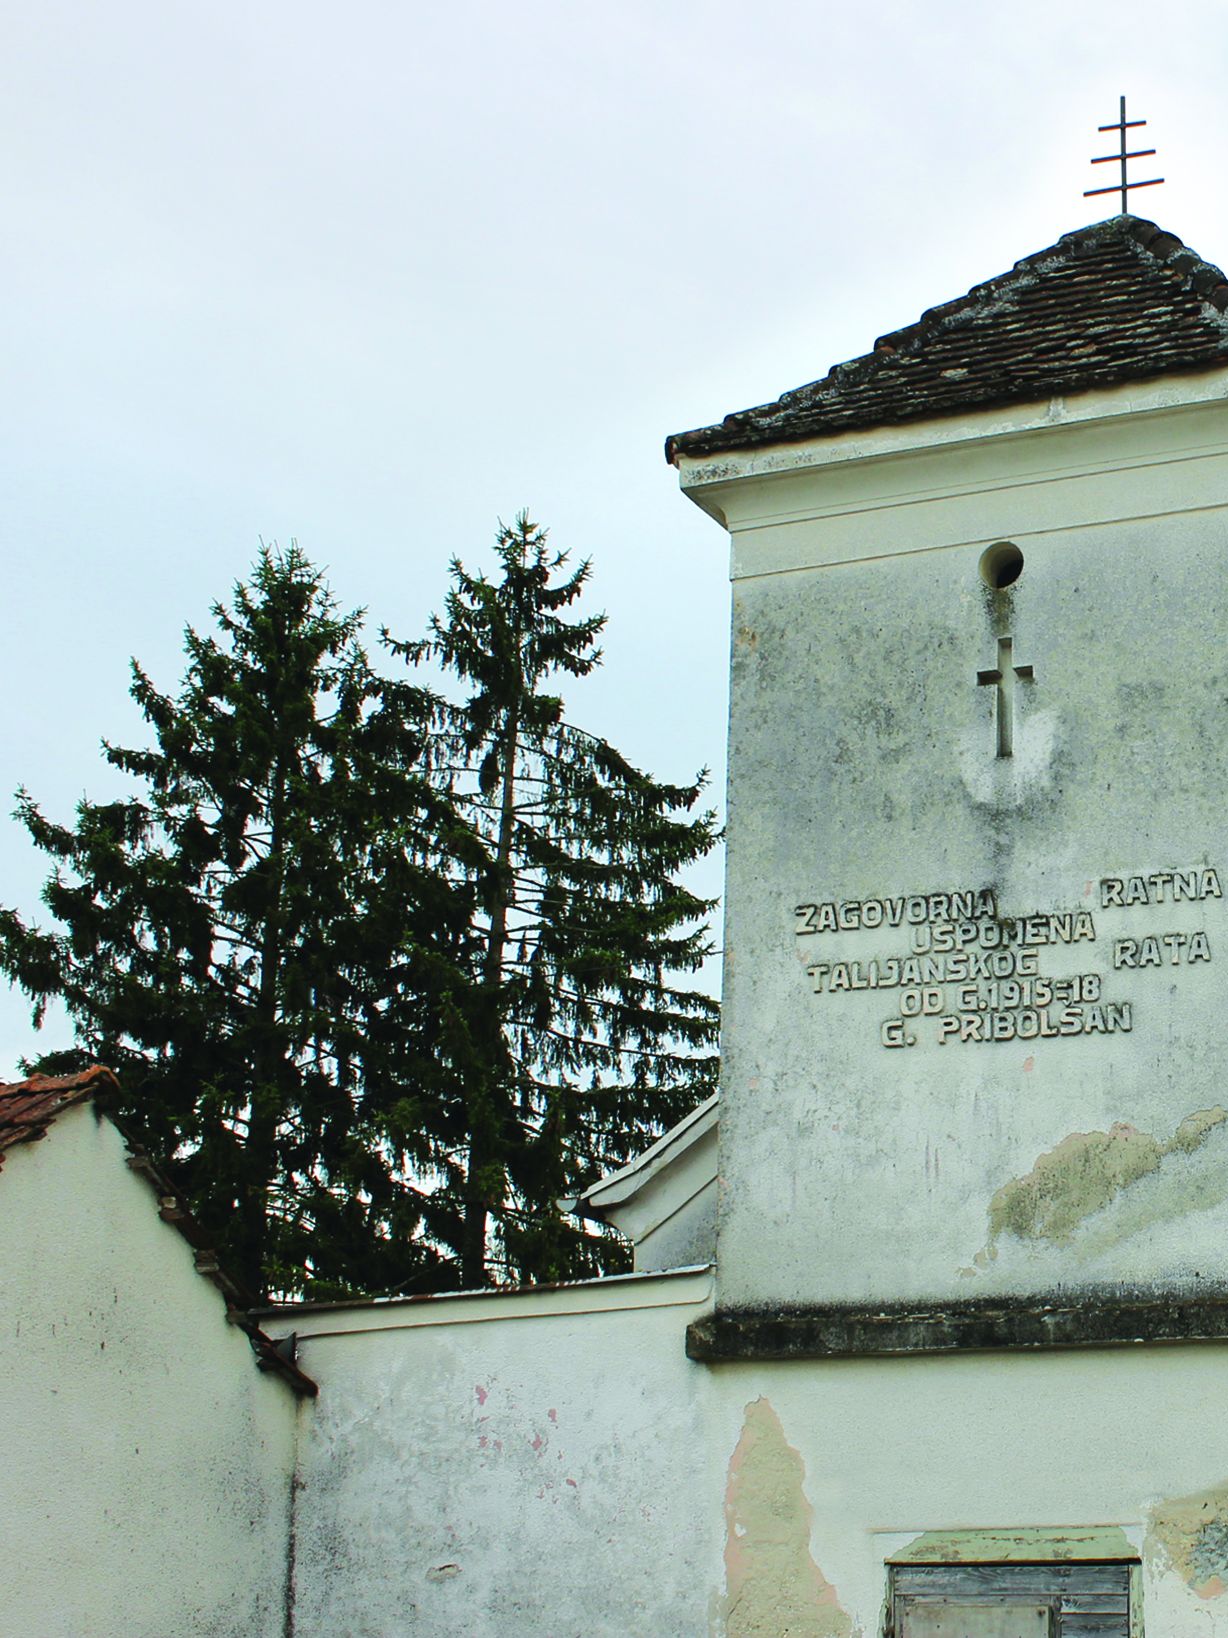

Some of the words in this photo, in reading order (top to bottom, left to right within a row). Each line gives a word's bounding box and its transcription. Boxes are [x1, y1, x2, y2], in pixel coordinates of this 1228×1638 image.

[795, 888, 996, 936] ZAGOVORNA
[1102, 868, 1222, 908] RATNA
[911, 911, 1096, 956] USPOMENA
[807, 948, 1039, 994] TALIJANSKOG
[1115, 931, 1212, 970] RATA
[882, 1018, 918, 1048] G.
[938, 999, 1133, 1045] PRIBOLŠAN
[901, 987, 945, 1016] OD
